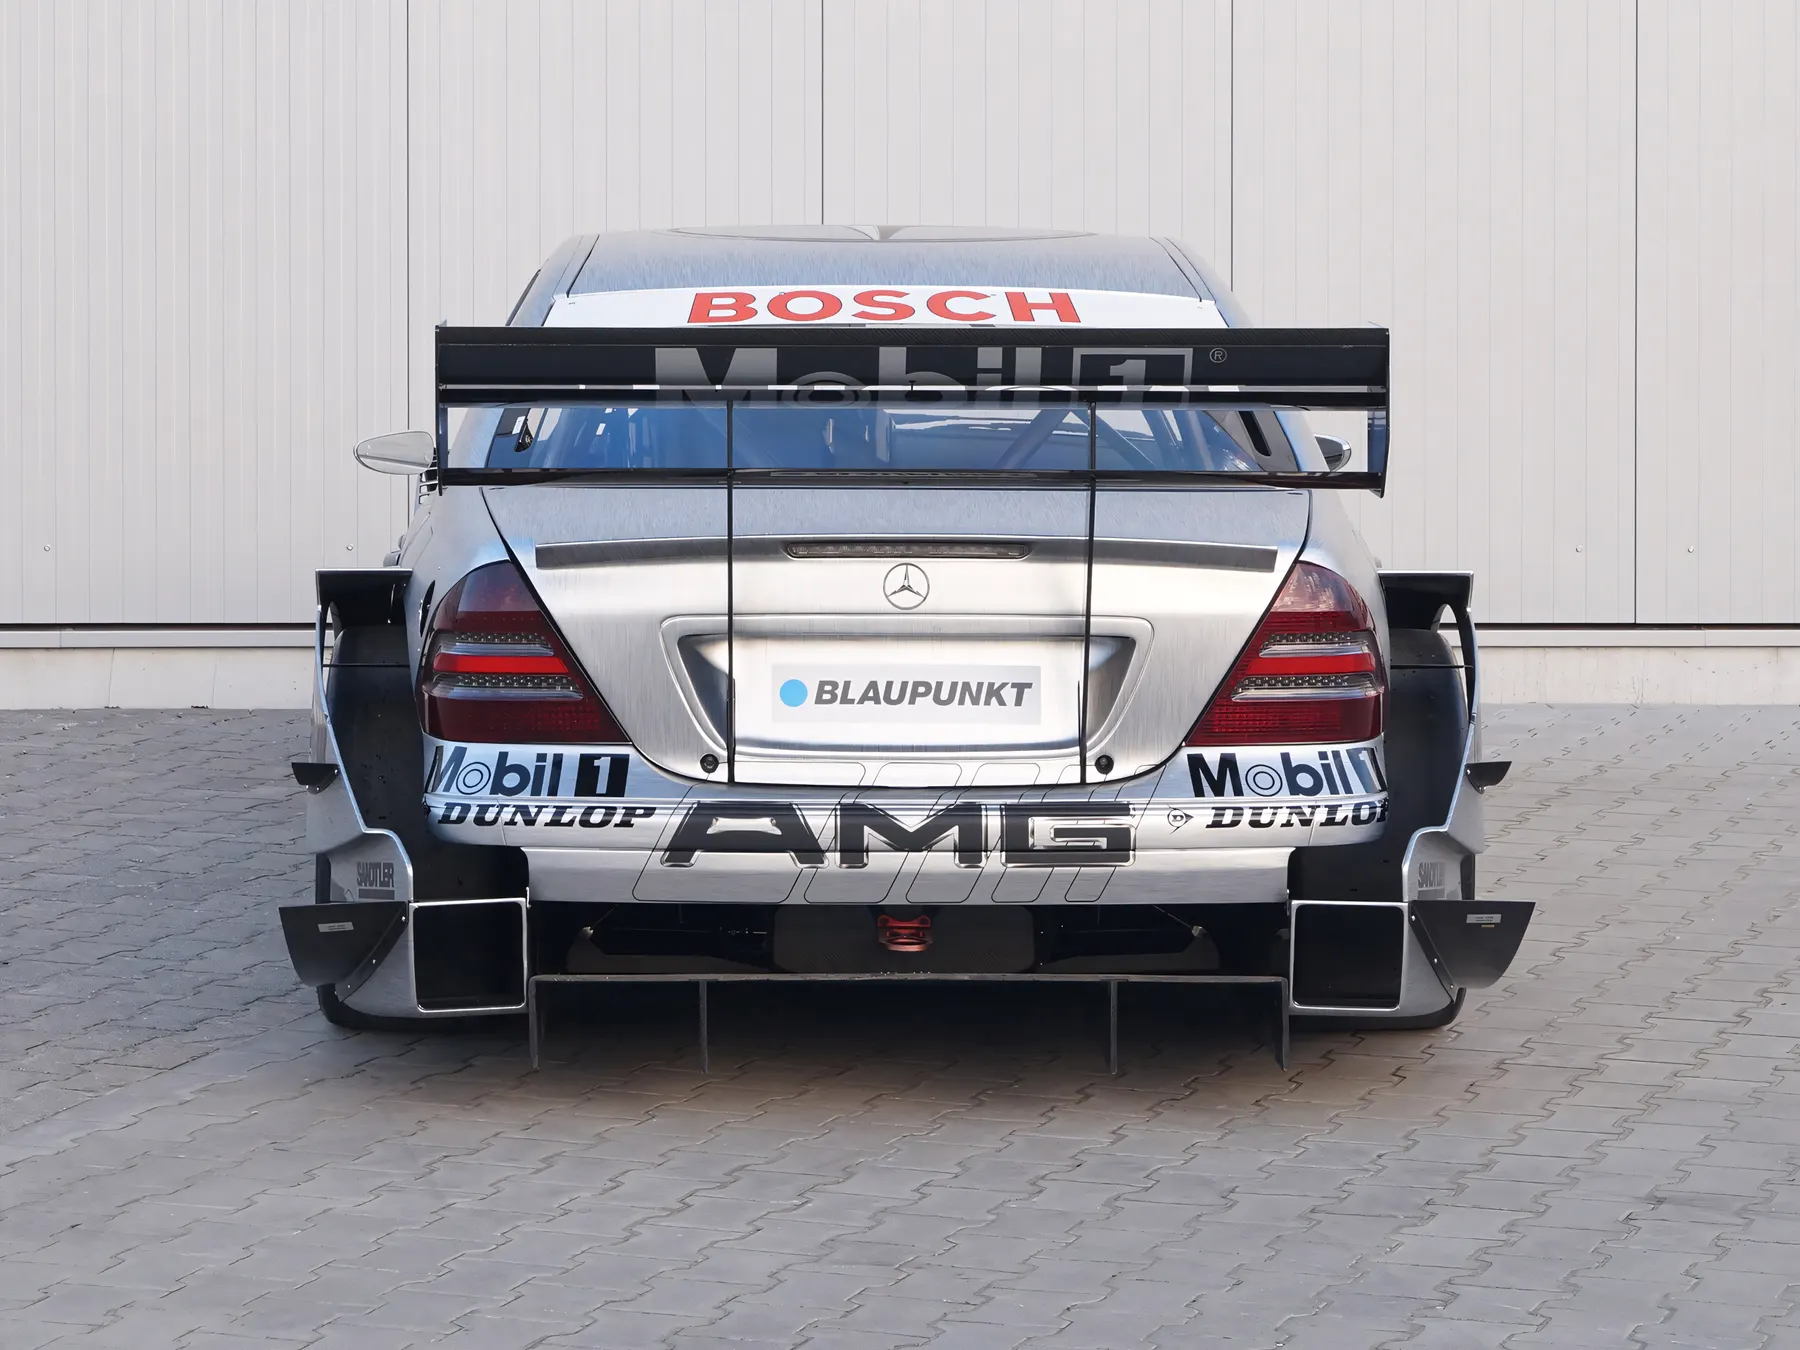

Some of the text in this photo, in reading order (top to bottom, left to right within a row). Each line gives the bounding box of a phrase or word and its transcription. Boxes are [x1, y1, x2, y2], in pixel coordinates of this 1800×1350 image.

[687, 290, 1082, 324] BOSCH
[655, 346, 1042, 406] Mobil
[814, 680, 1033, 707] BLAUPUNKT
[425, 745, 563, 797] Mobil
[1187, 749, 1355, 798] Mobil
[437, 802, 657, 829] DUNLOP
[660, 800, 1137, 869] AMG
